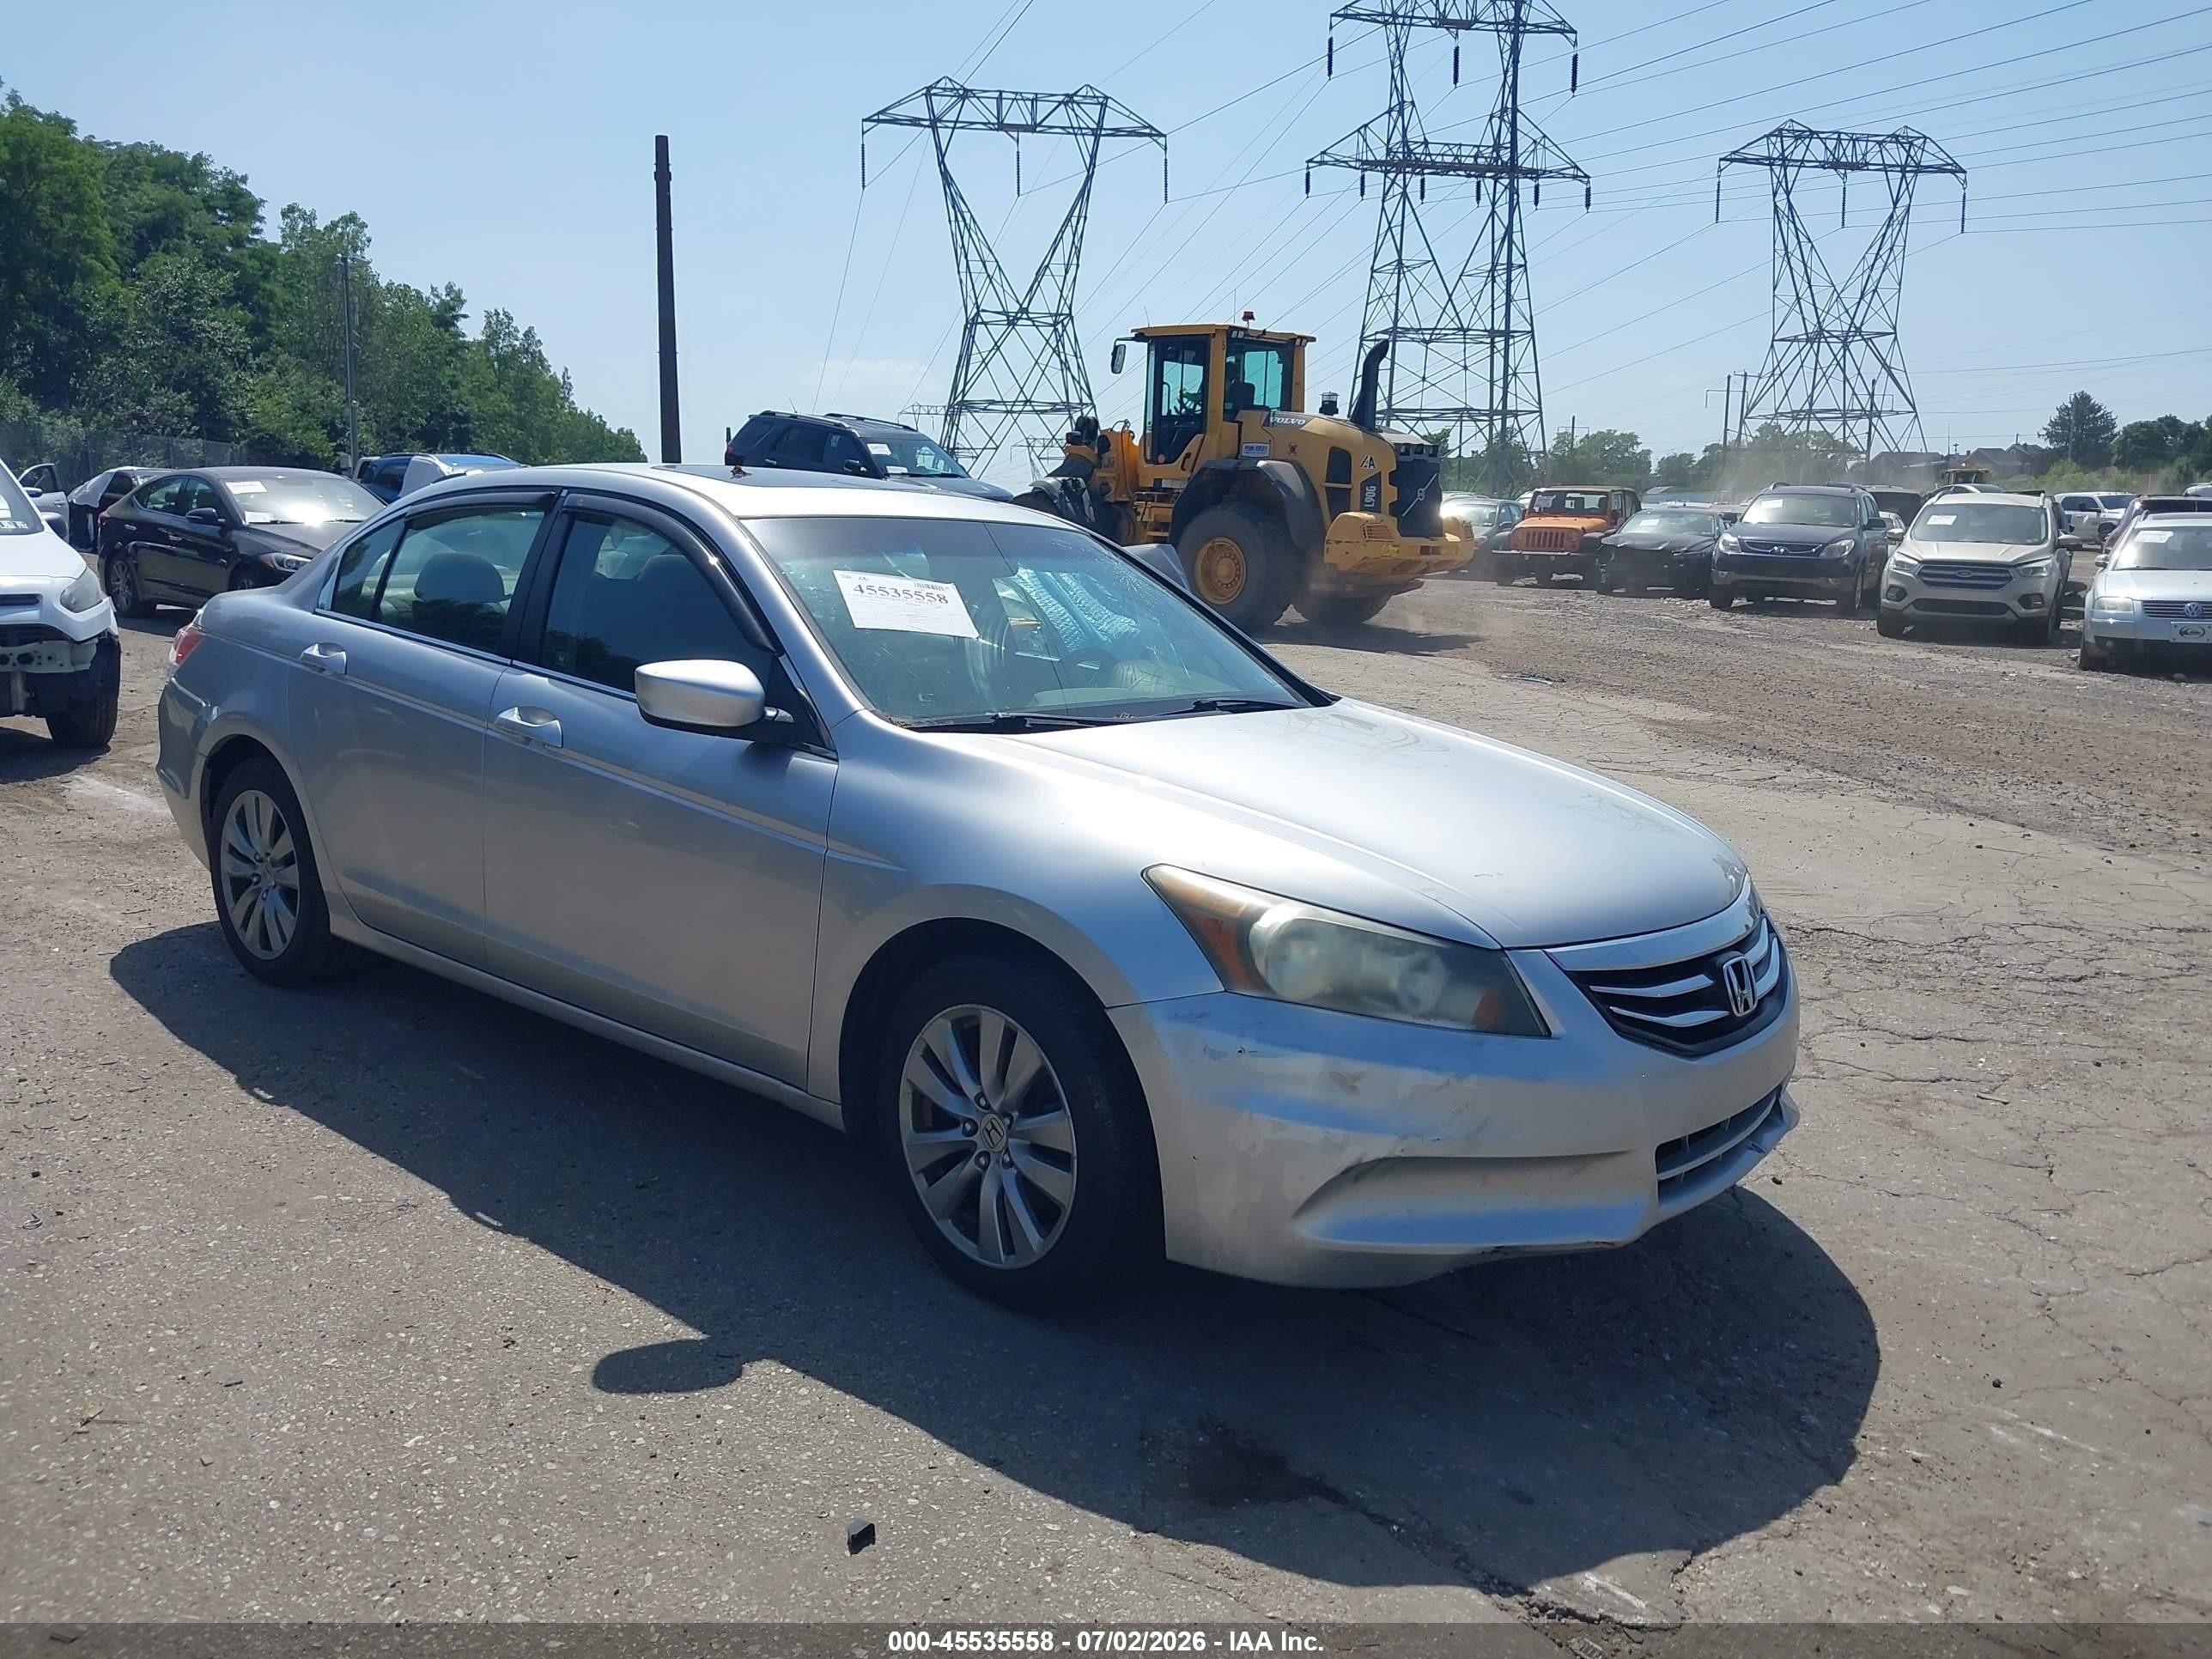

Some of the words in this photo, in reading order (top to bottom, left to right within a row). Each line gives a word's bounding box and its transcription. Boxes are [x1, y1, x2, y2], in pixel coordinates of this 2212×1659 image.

[1270, 416, 1306, 425] VOLVO
[1364, 485, 1376, 507] L90G
[854, 584, 949, 605] 45535558
